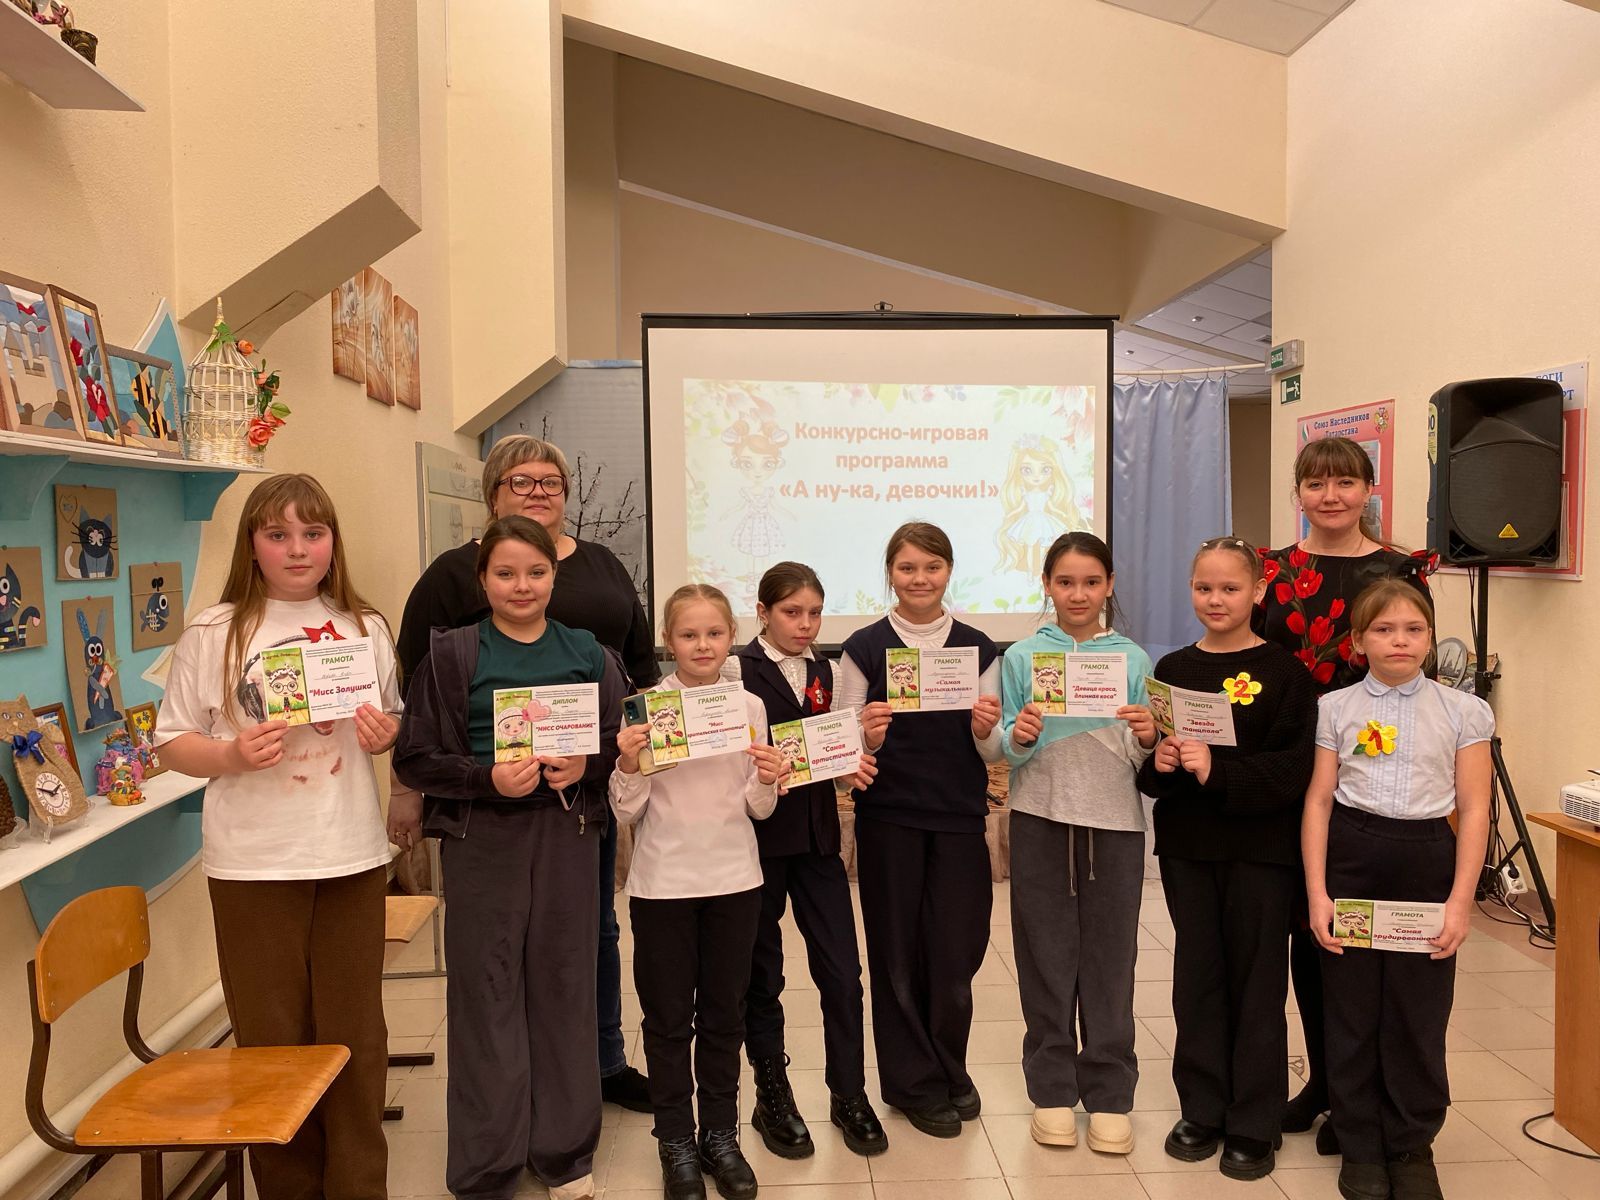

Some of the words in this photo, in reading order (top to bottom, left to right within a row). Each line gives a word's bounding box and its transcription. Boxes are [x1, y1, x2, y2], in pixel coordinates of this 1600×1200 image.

[1314, 421, 1329, 430] Союз
[1329, 413, 1370, 427] Наследников
[794, 422, 989, 444] Конкурсно-игровая
[836, 454, 948, 472] программа
[779, 479, 809, 498] «А
[815, 483, 880, 502] ну-ка,
[885, 479, 999, 502] девочки!»
[321, 655, 354, 665] ГРАМОТА
[335, 681, 376, 694] Золушка"
[1234, 680, 1251, 698] 2
[697, 695, 727, 704] ГРАМОТА
[815, 689, 823, 705] 3
[1184, 701, 1213, 709] ГРАМОТА
[817, 722, 842, 732] ГРАМОТА
[1368, 729, 1383, 750] 1
